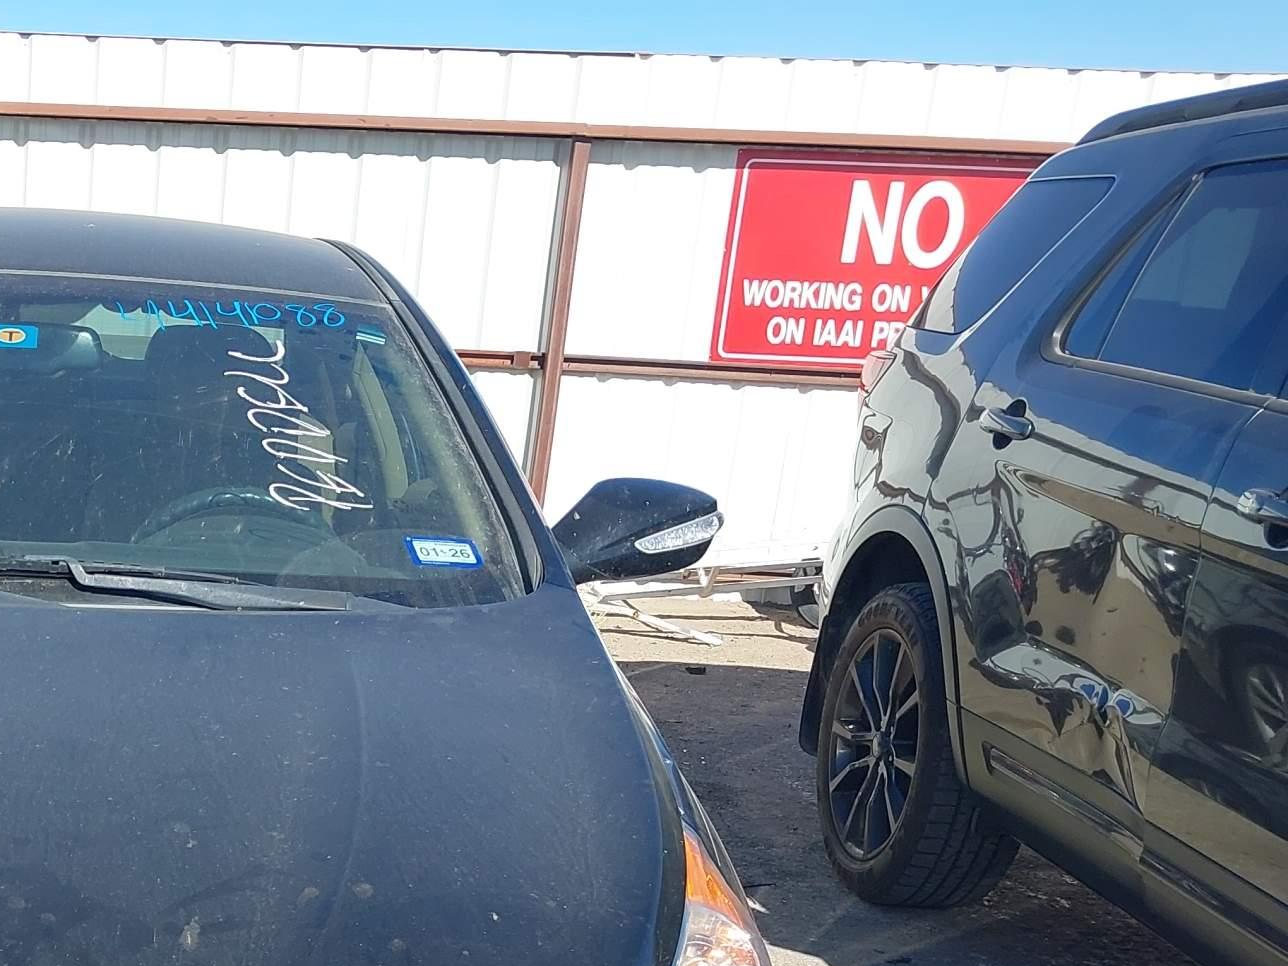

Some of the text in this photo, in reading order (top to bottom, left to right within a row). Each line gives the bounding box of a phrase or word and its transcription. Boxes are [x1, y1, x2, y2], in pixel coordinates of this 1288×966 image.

[840, 179, 964, 269] NO
[743, 279, 863, 311] WORKING
[872, 283, 912, 313] ON
[766, 316, 806, 345] ON
[813, 318, 864, 347] IAAI
